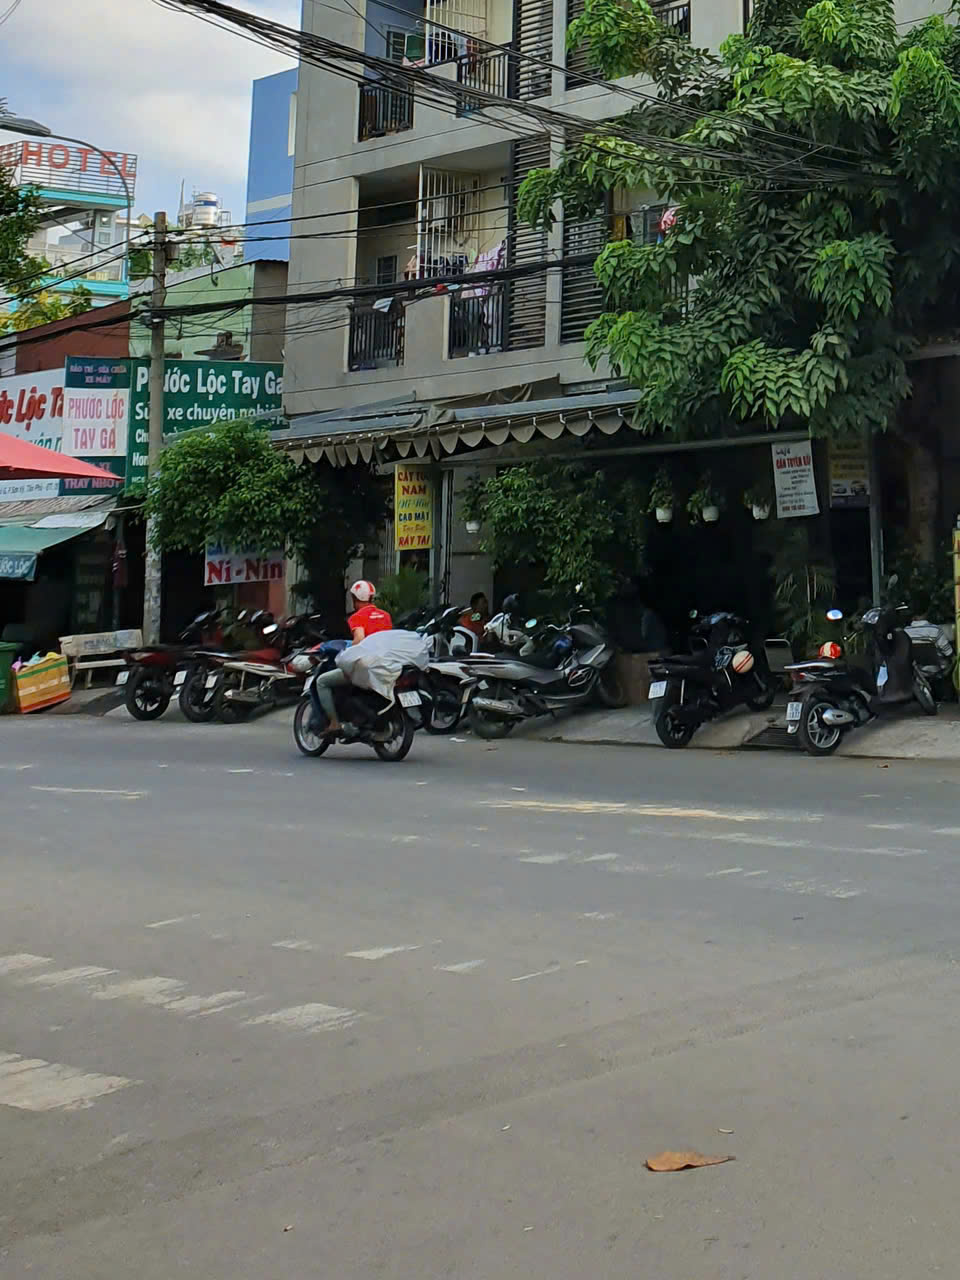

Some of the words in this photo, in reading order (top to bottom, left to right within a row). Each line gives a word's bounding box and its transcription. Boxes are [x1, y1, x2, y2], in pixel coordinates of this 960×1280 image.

[22, 141, 136, 177] HOTEL
[197, 368, 226, 400] Lộc
[232, 370, 260, 399] Tay
[15, 386, 47, 431] Lộc
[167, 406, 184, 420] xe
[187, 402, 236, 424] chuyên
[73, 428, 96, 449] TAY
